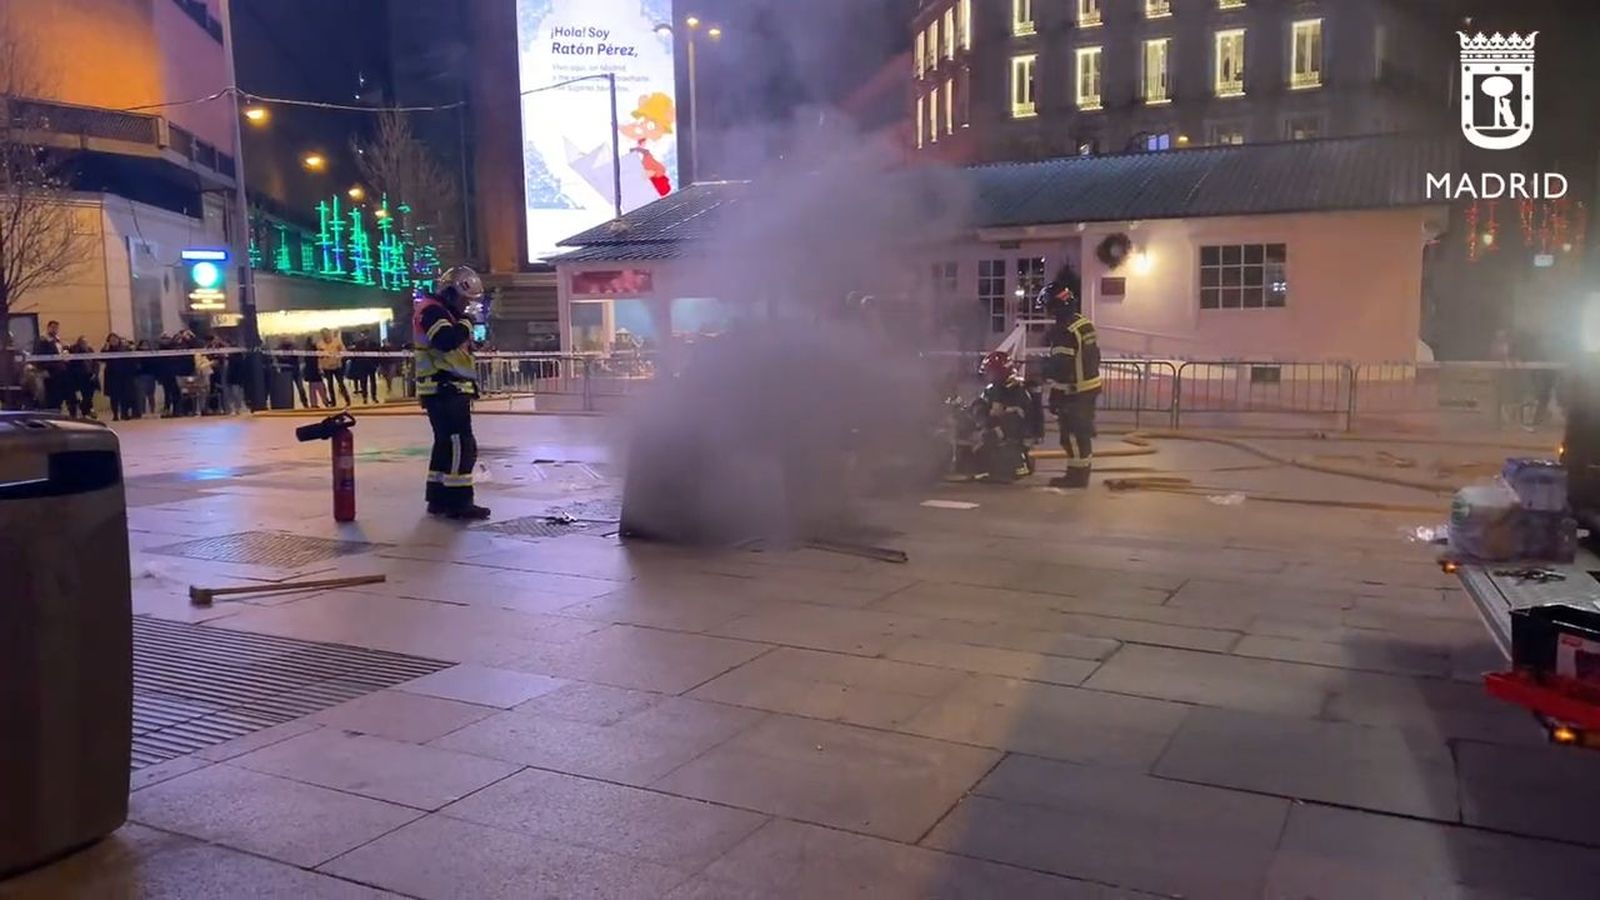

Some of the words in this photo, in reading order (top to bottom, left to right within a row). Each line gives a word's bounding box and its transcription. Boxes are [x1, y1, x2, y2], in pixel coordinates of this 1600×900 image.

[551, 26, 587, 39] ¡Hola!
[588, 27, 610, 40] Soy
[552, 42, 594, 55] Ratón
[597, 43, 638, 57] Pérez,
